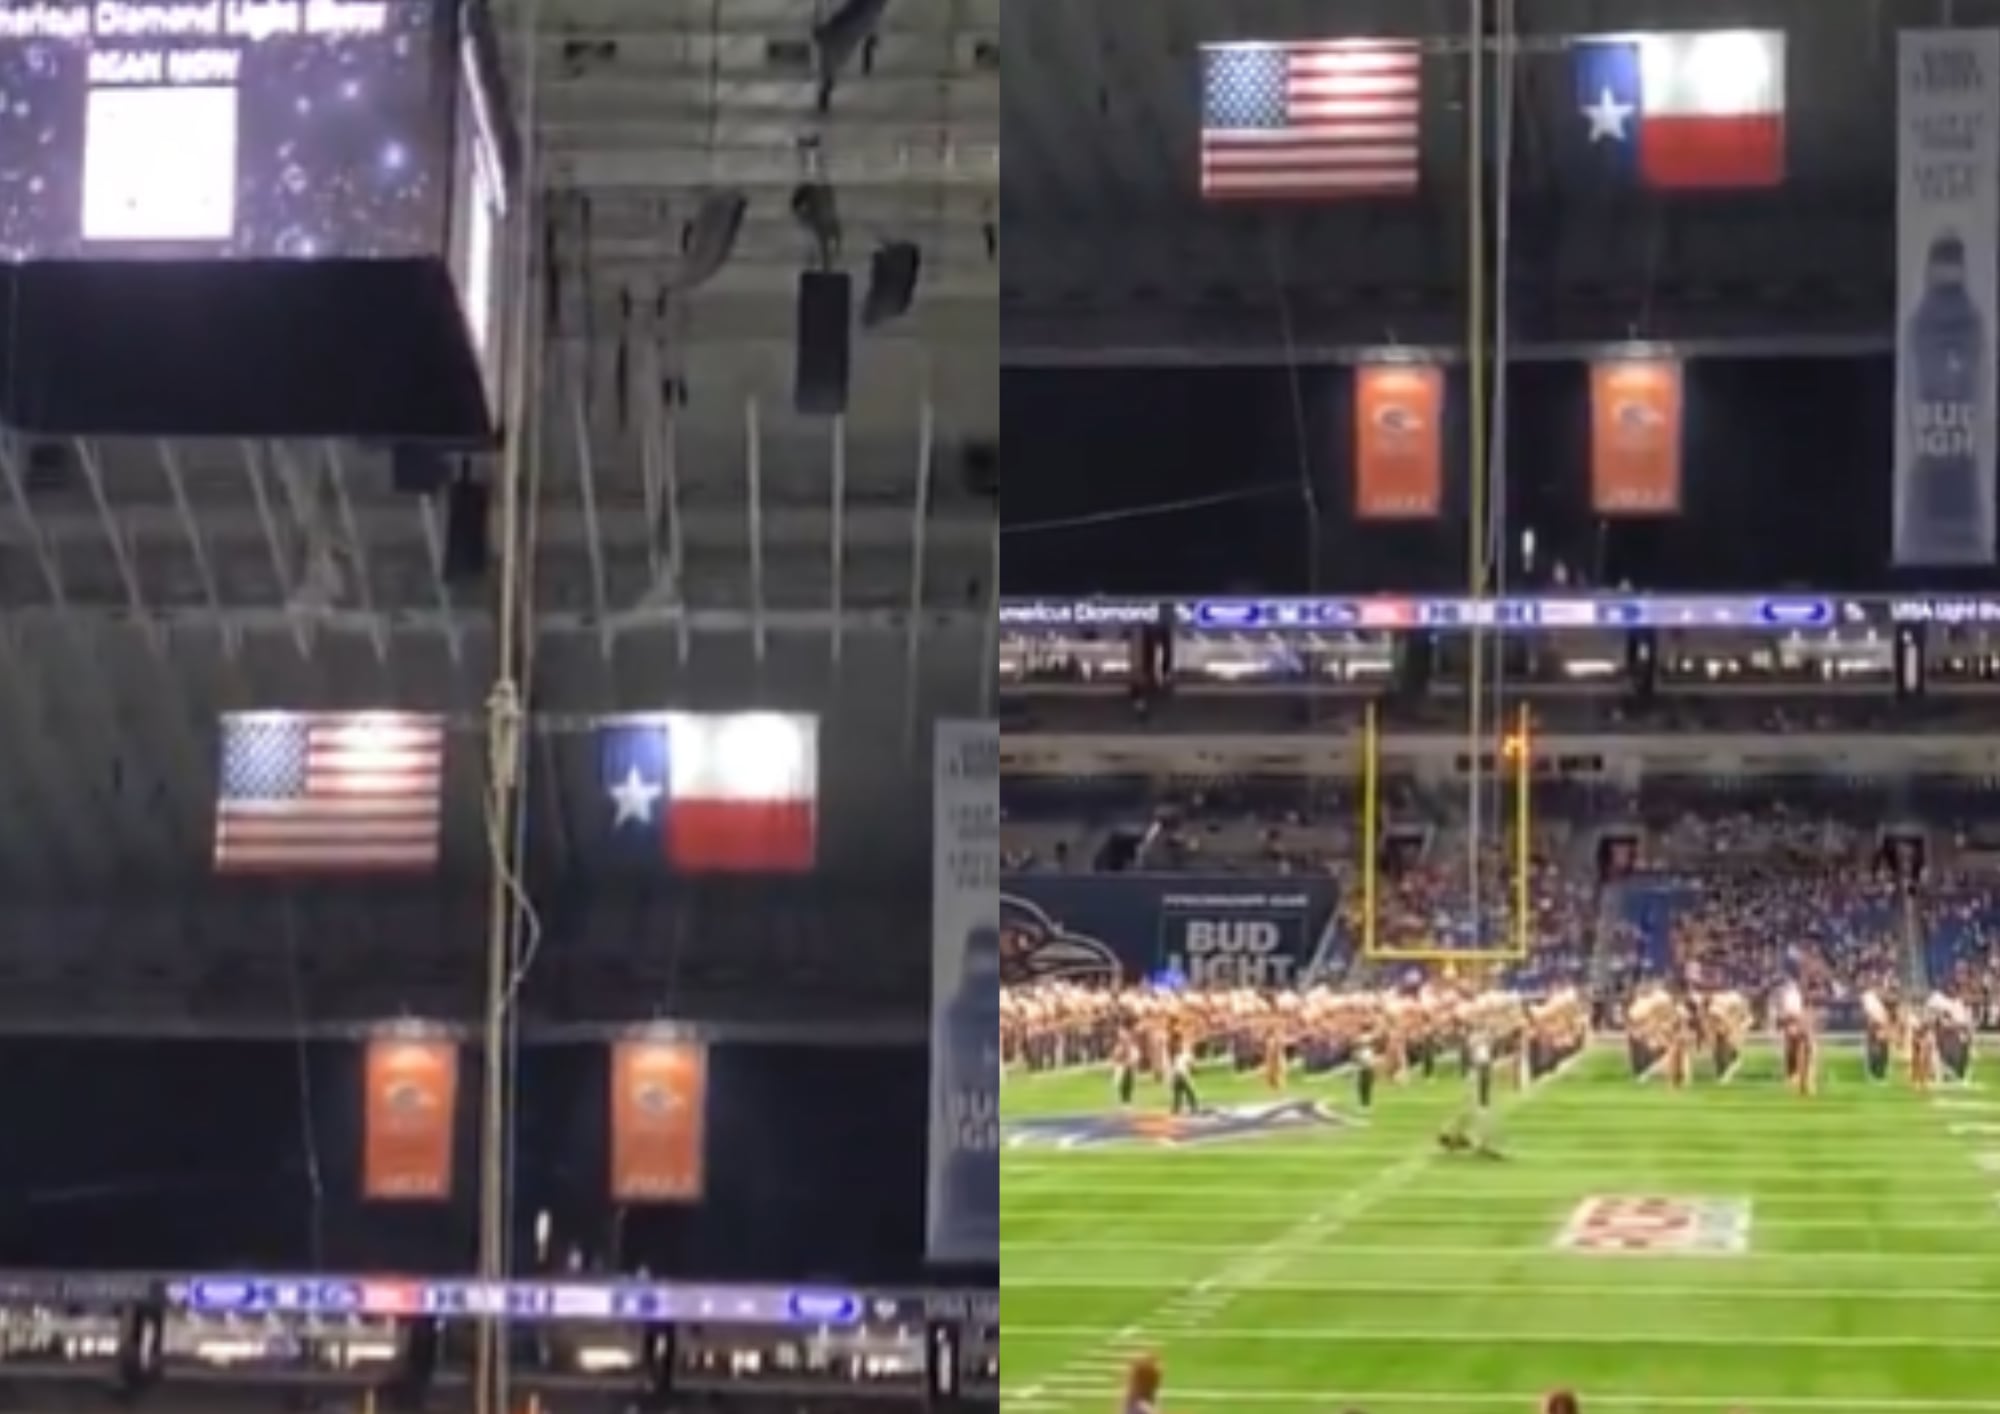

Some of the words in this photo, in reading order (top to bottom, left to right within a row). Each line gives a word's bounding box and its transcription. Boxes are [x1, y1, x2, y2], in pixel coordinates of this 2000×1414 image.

[96, 2, 218, 34] Diamond
[226, 1, 298, 41] Light
[304, 1, 388, 34] Show
[88, 51, 163, 81] SCAN
[168, 50, 240, 82] NOW
[1074, 601, 1158, 623] Diamond
[1186, 921, 1279, 953] BUD
